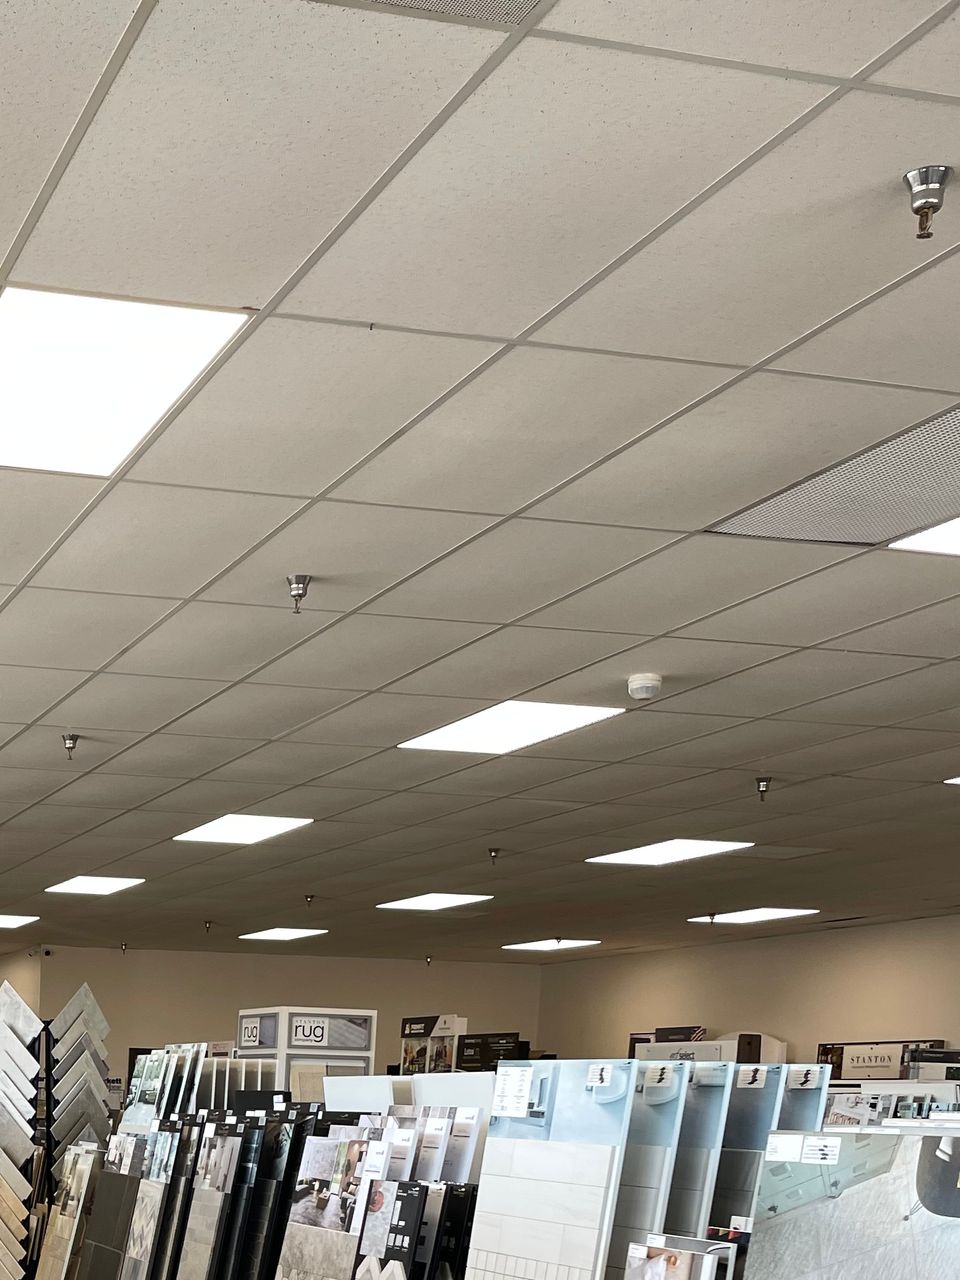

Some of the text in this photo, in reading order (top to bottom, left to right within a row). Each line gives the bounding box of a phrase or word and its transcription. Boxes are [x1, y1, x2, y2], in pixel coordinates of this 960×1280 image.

[243, 1025, 258, 1042] rug
[294, 1024, 324, 1042] rug
[850, 1055, 893, 1065] STANTON
